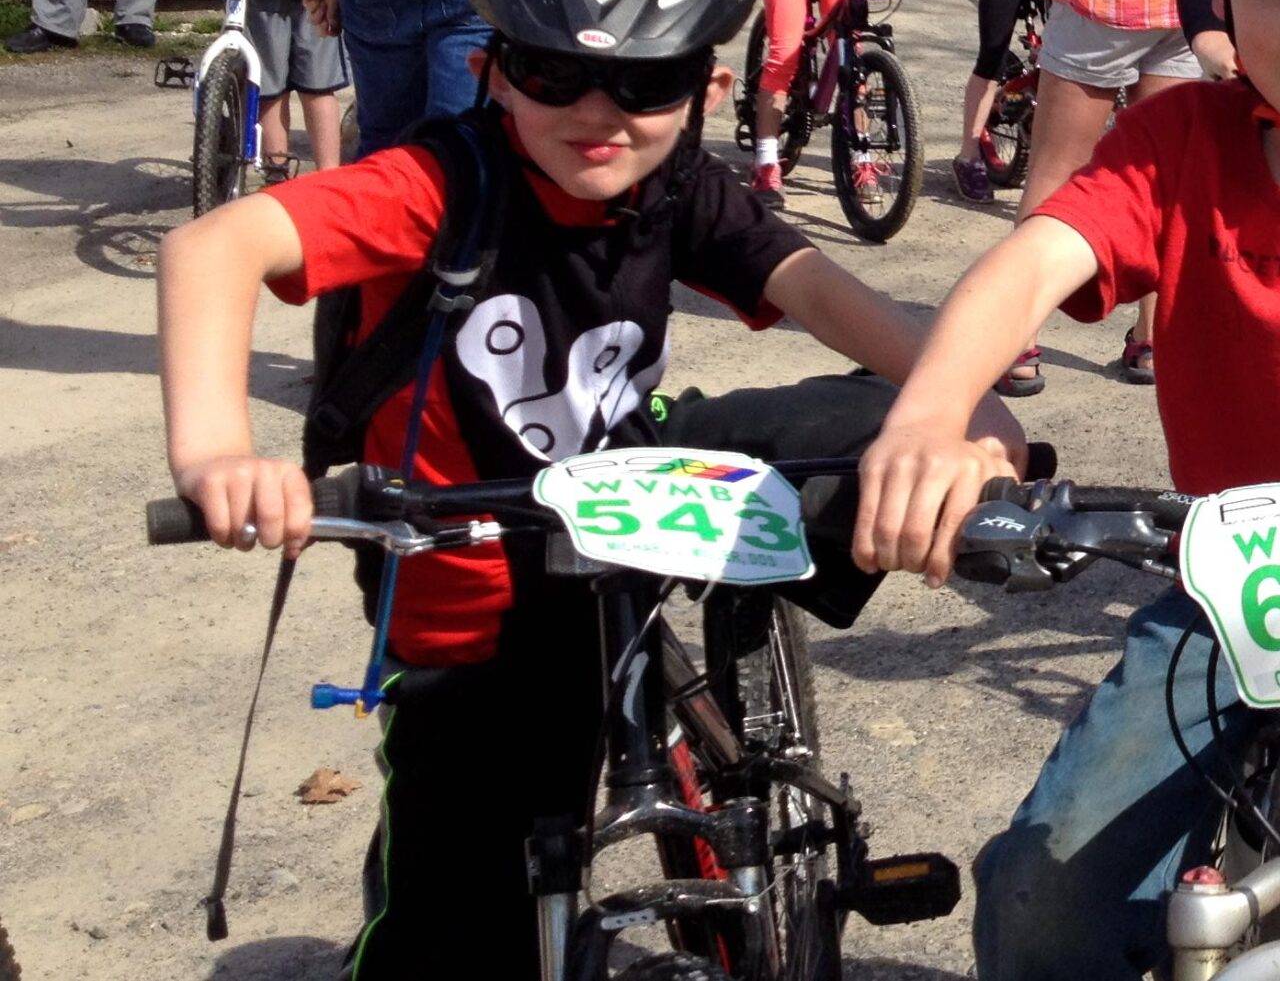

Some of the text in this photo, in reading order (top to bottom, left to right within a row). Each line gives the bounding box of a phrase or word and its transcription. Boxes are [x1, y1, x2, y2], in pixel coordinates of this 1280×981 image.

[583, 32, 611, 45] BELL
[582, 479, 772, 508] WVMBA
[576, 499, 801, 552] 543
